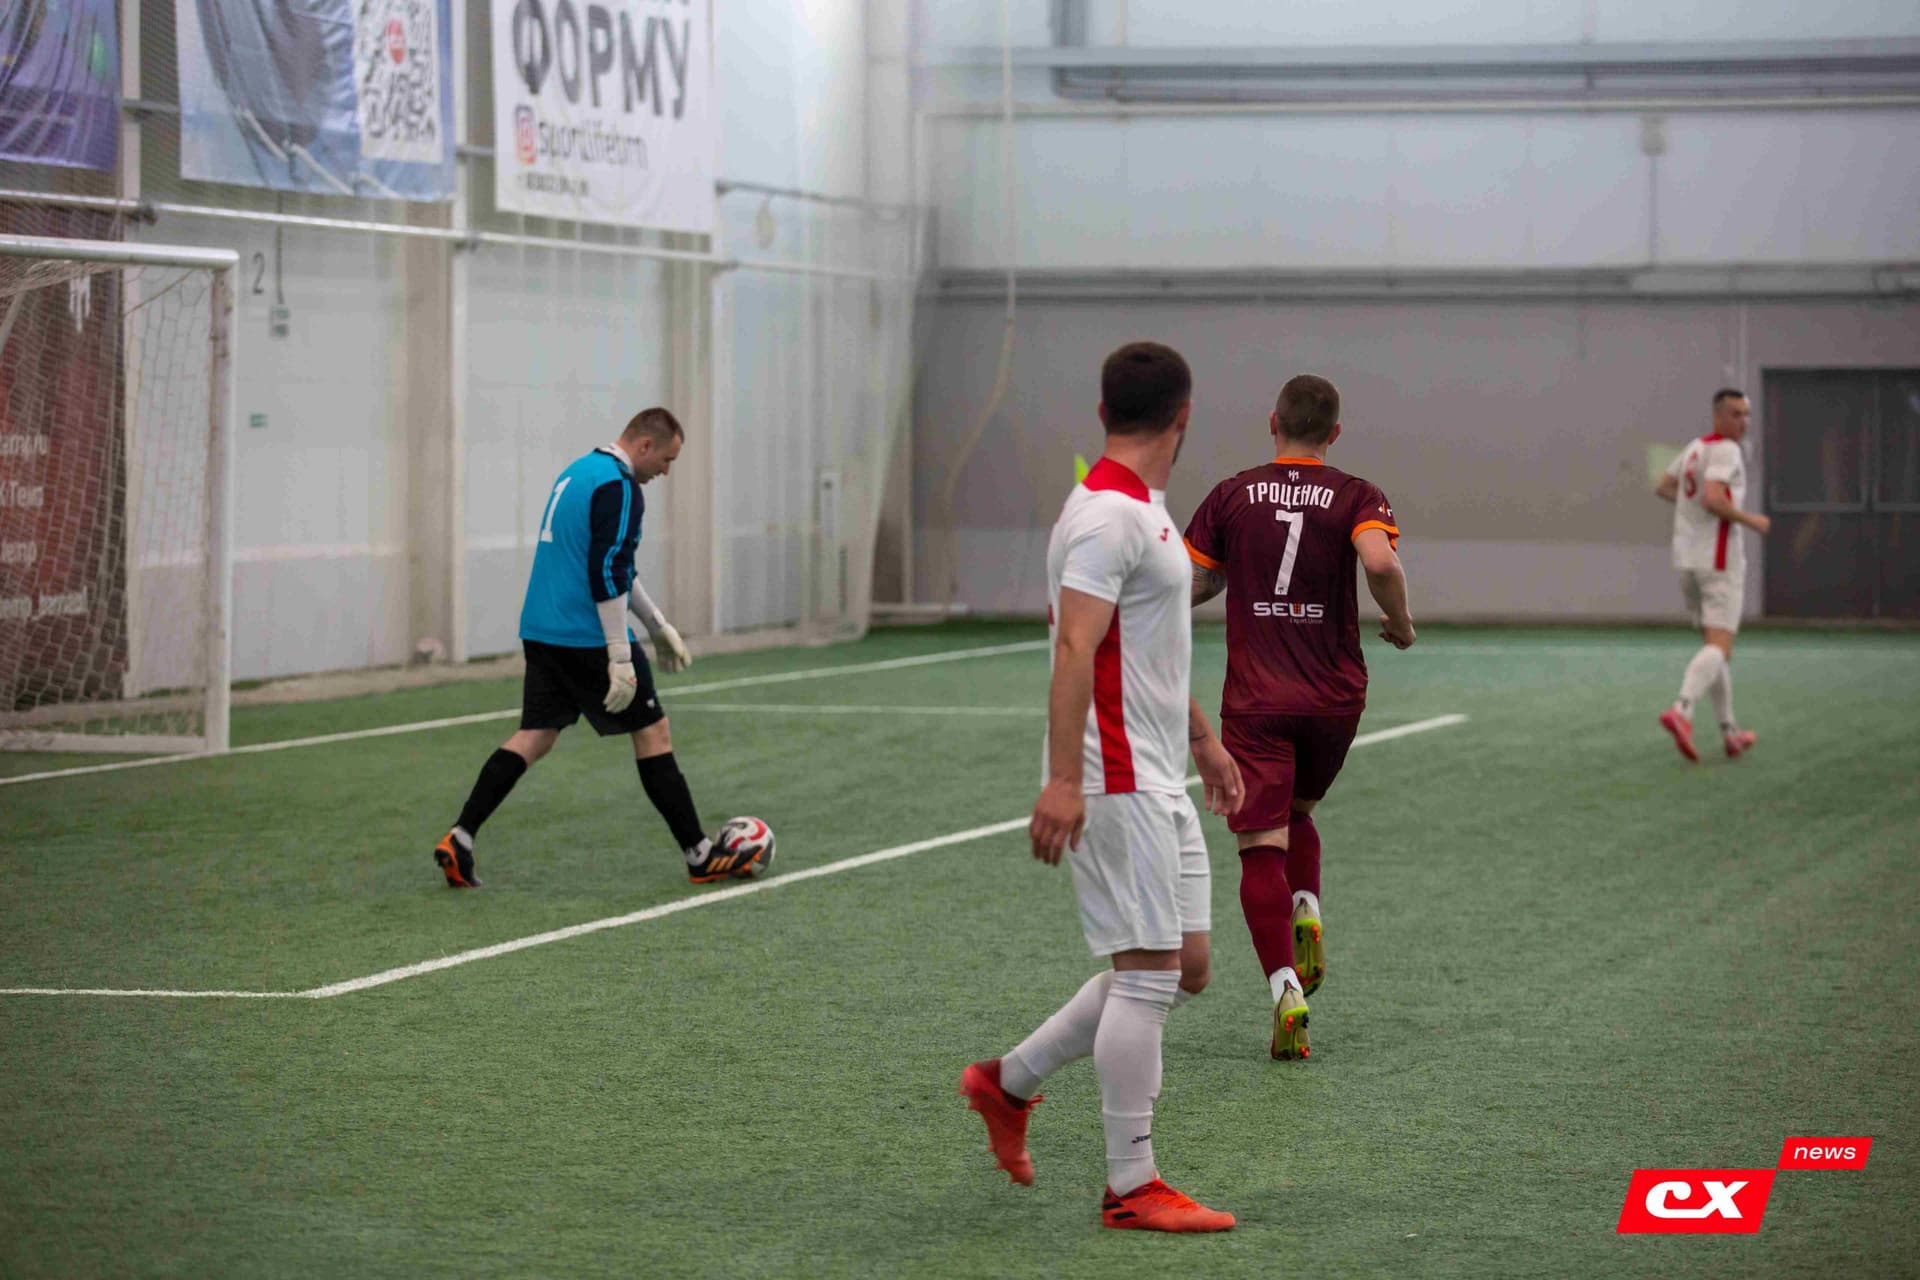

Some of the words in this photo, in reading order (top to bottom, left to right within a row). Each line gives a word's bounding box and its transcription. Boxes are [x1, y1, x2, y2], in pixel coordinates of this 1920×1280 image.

[513, 0, 690, 119] ФОРМУ
[252, 251, 265, 294] 2
[540, 476, 572, 543] 1
[1246, 482, 1335, 510] ТРОЦЕНКО
[1275, 510, 1304, 596] 7
[1253, 601, 1325, 619] SEUS
